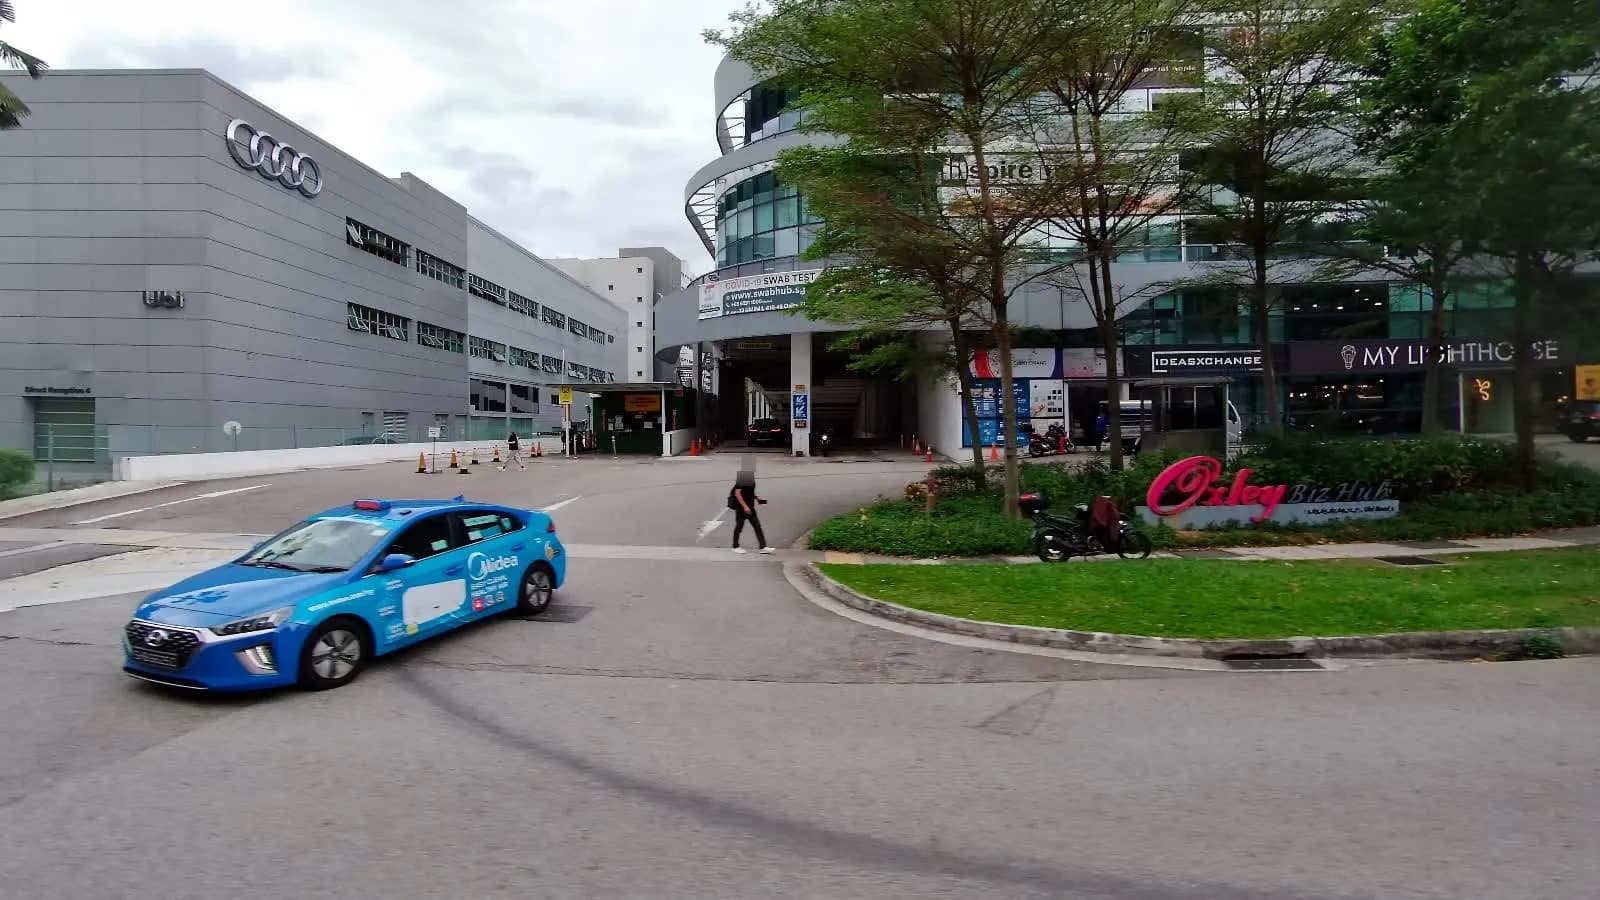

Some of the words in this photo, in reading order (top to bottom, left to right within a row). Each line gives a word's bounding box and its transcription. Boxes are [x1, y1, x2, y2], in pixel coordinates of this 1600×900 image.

[725, 278, 761, 290] COVID-19
[763, 274, 790, 285] SWAB
[791, 272, 816, 282] TEST
[142, 290, 184, 309] Ubi
[1155, 356, 1262, 366] IDEASXCHANGE
[1363, 346, 1399, 366] MY
[1146, 455, 1288, 523] Oxley
[474, 553, 519, 577] Midea
